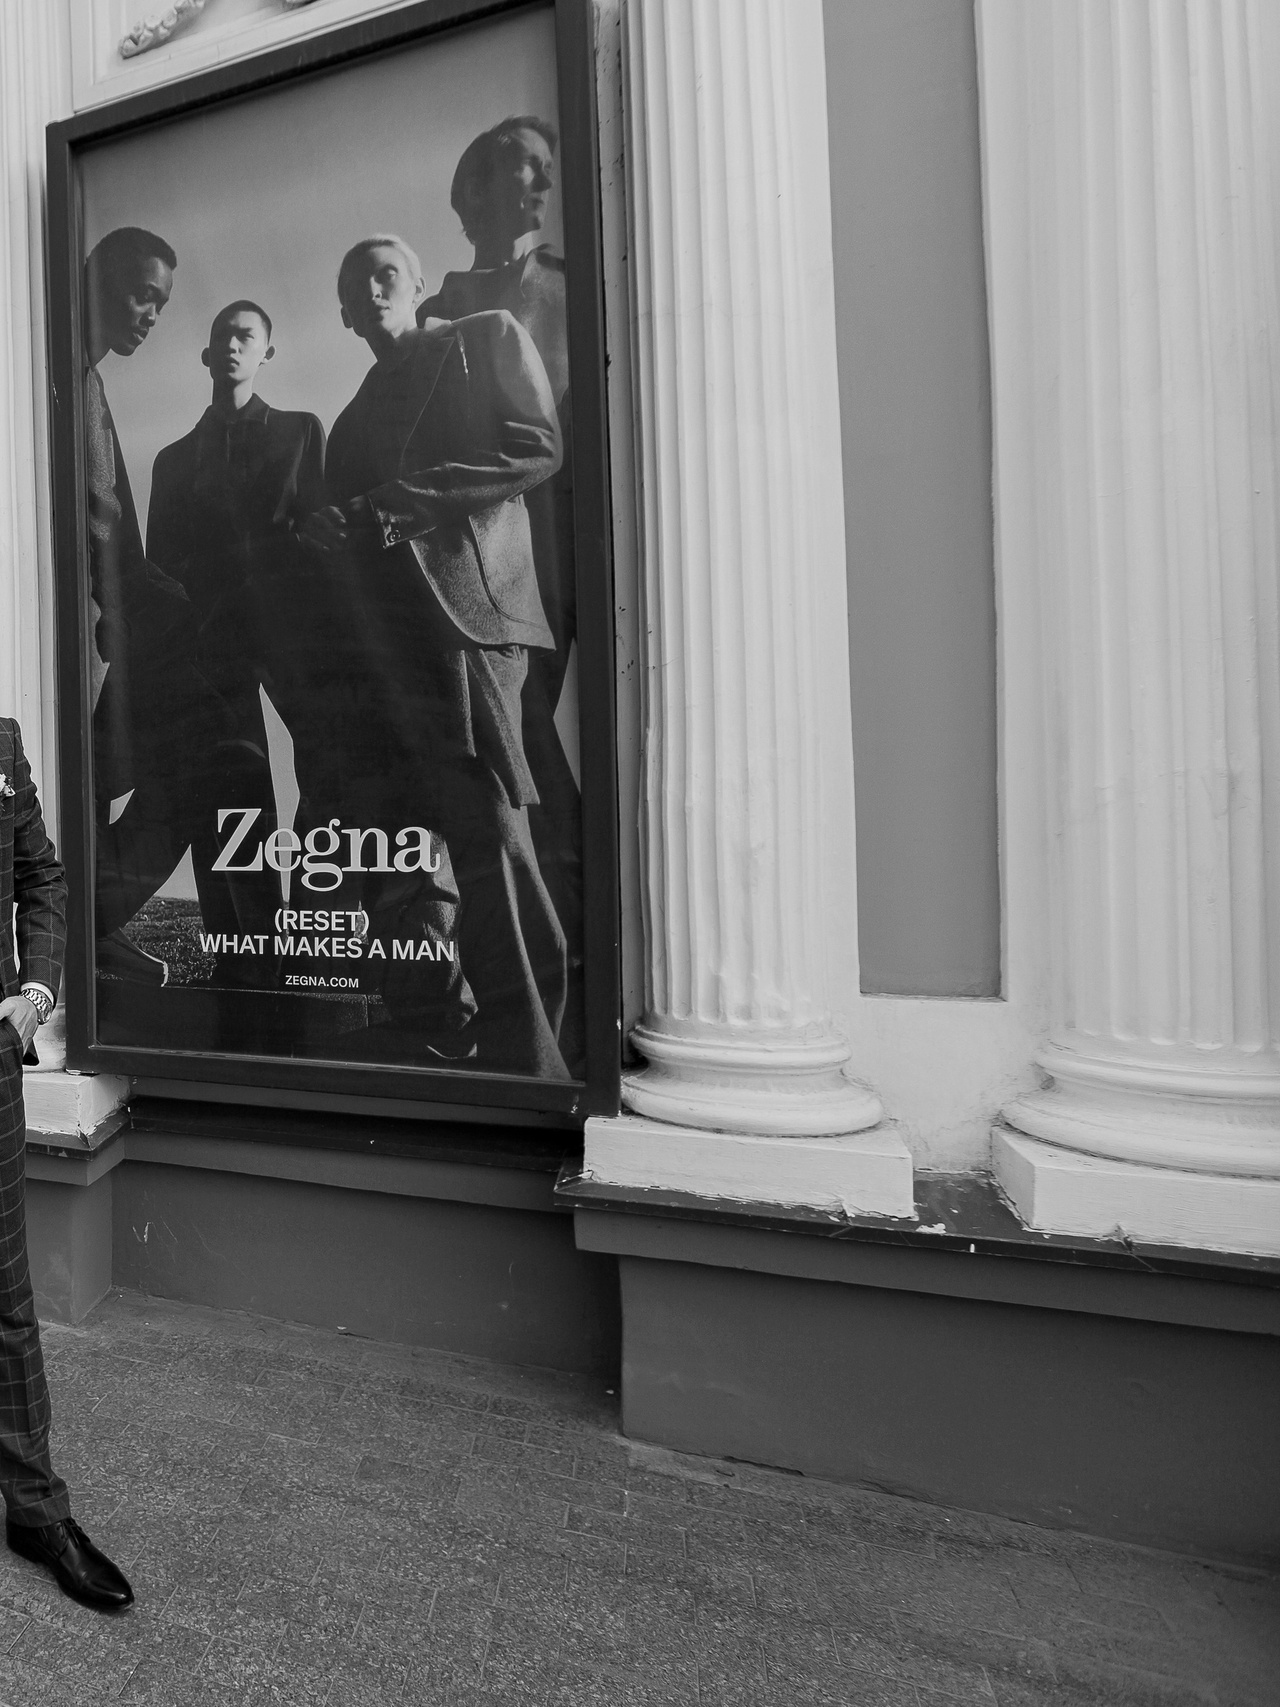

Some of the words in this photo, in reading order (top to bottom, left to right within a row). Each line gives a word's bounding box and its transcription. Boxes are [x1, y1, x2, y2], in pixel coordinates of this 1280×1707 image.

[211, 807, 441, 891] Zegna
[274, 908, 370, 936] (RESET)
[199, 934, 269, 955] WHAT
[274, 935, 363, 959] MAKES
[367, 938, 387, 960] A
[392, 940, 455, 962] MAN
[284, 975, 360, 989] ZEGNA.COM
